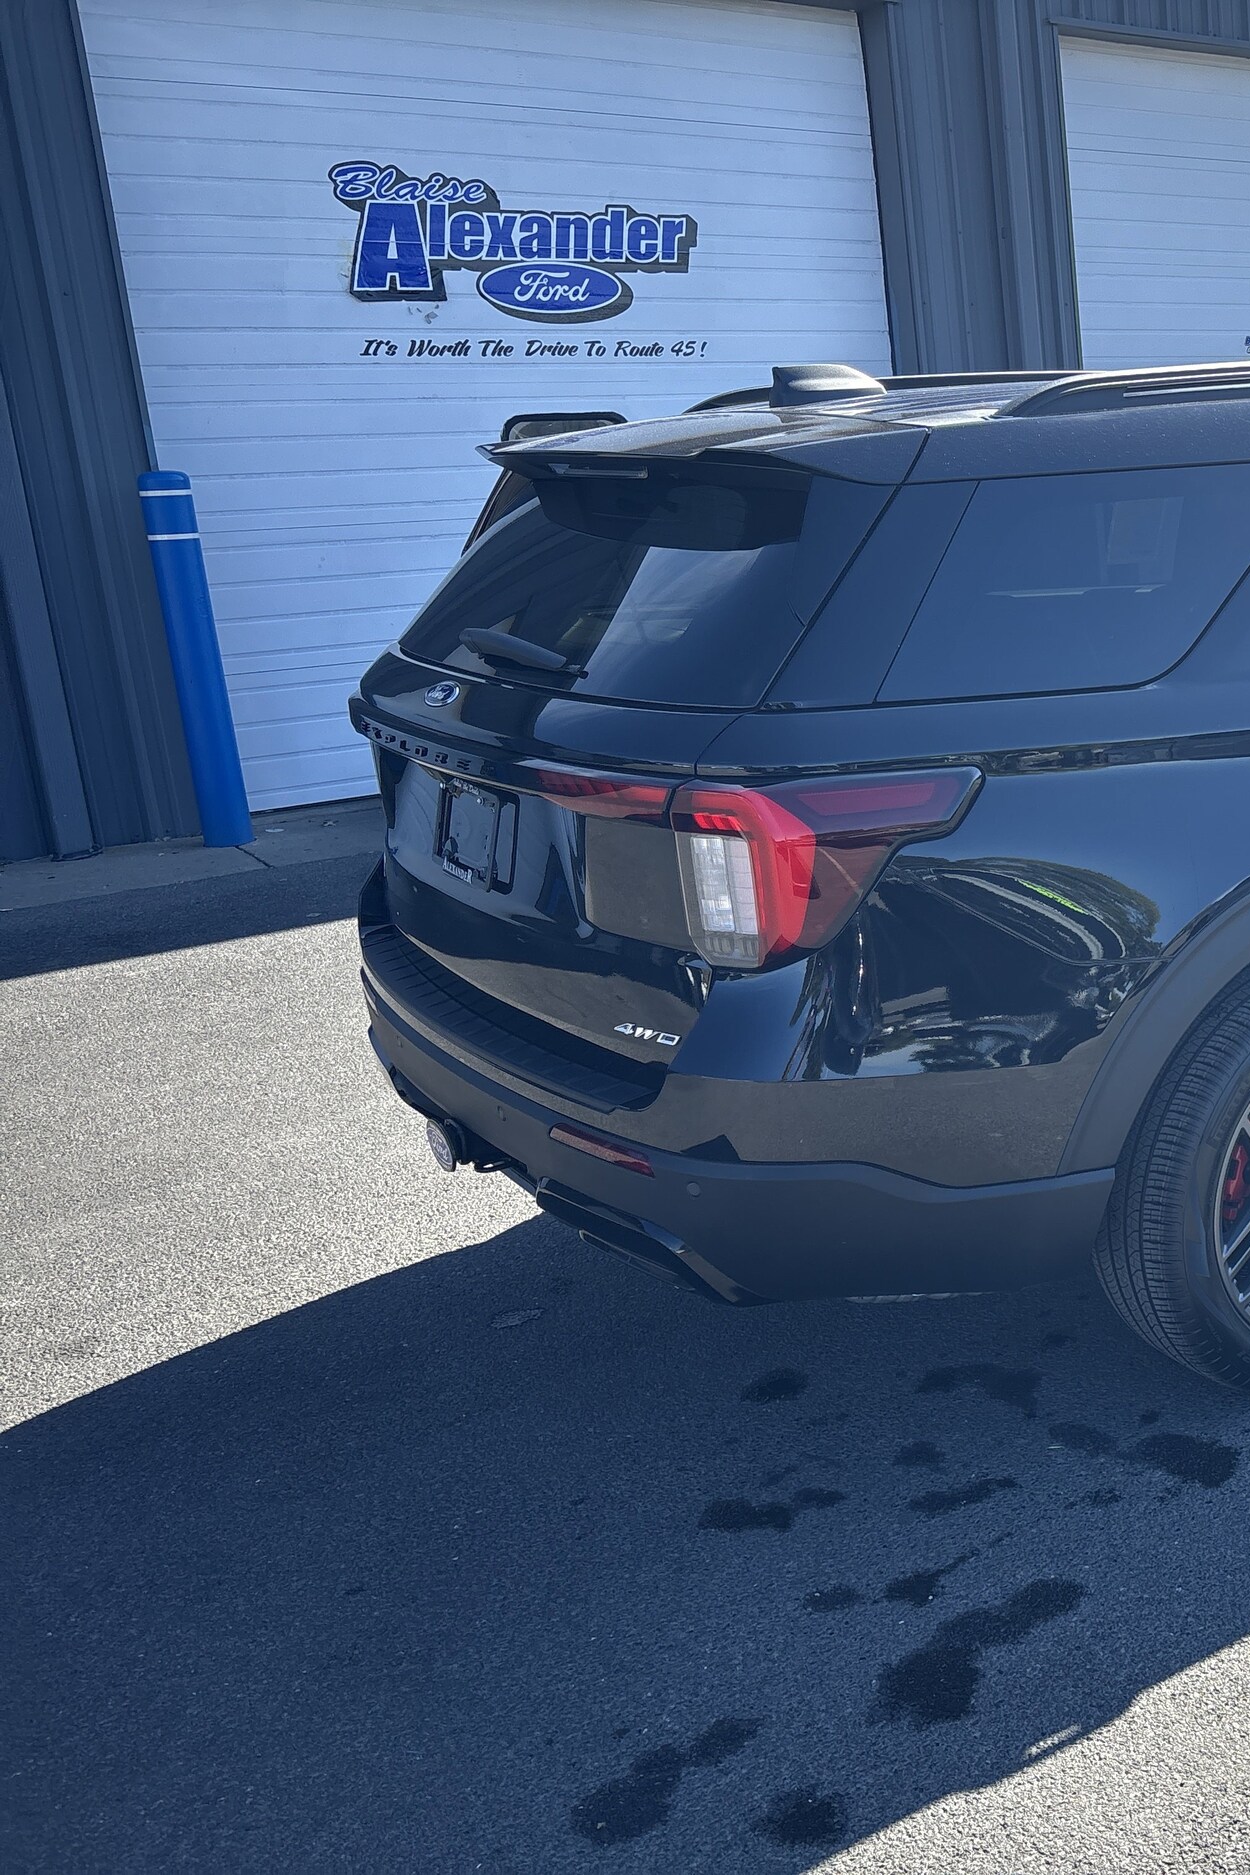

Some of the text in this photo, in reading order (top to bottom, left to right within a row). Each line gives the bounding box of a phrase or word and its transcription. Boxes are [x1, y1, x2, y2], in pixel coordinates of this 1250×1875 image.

[332, 163, 489, 203] Blaise
[353, 200, 690, 292] Alexander
[514, 270, 590, 303] Ford
[359, 338, 398, 358] It's
[407, 339, 472, 358] Worth
[477, 340, 514, 358] The
[525, 340, 579, 358] Drive
[582, 340, 606, 358] To
[613, 341, 665, 358] Route
[613, 1022, 681, 1046] 4WD
